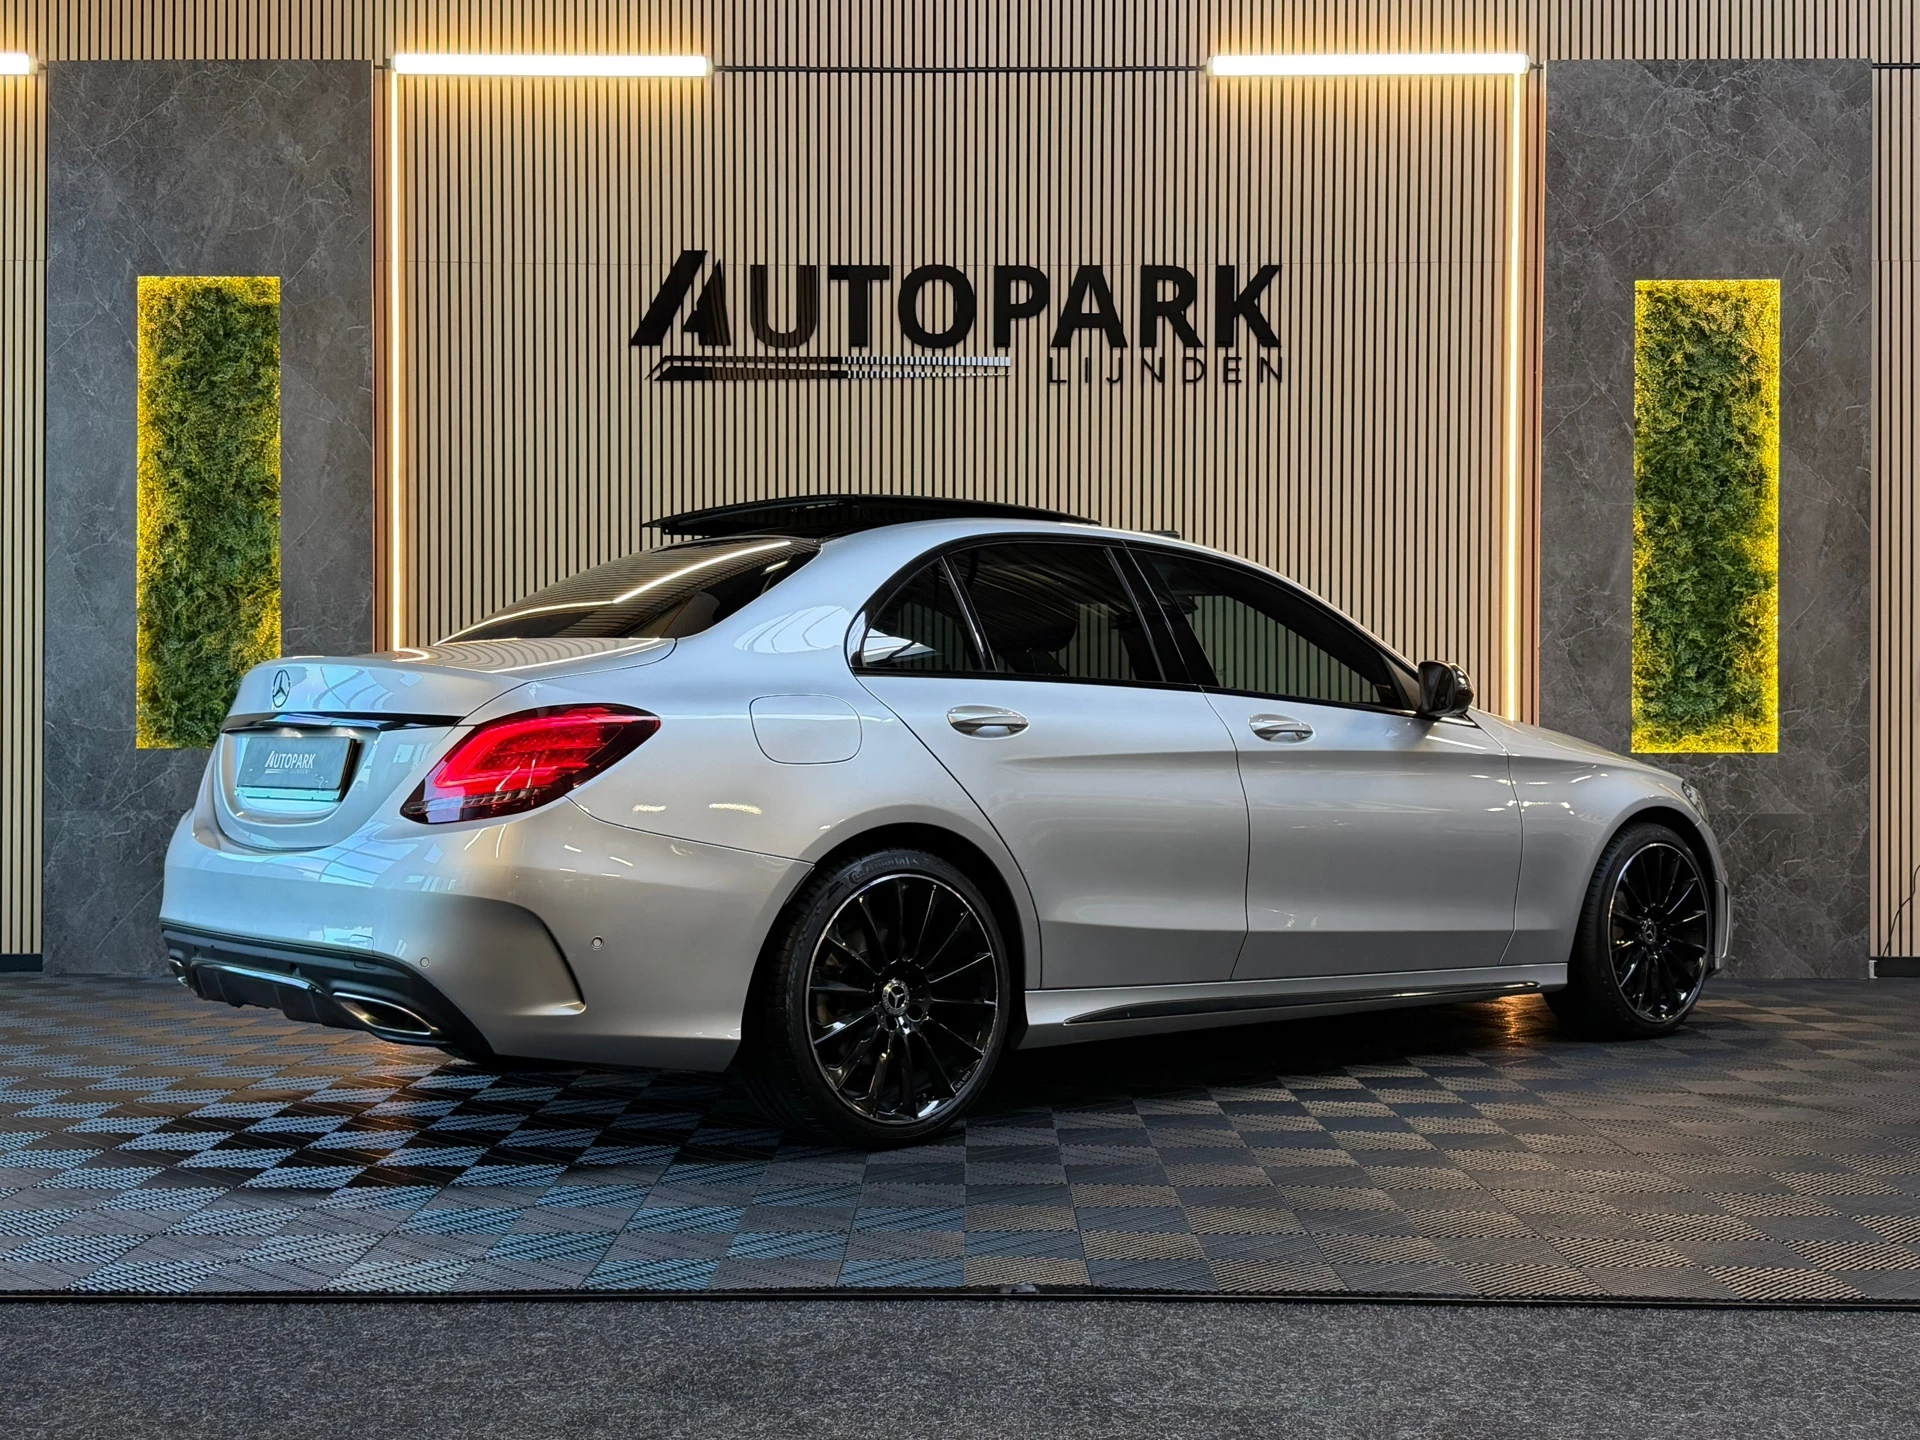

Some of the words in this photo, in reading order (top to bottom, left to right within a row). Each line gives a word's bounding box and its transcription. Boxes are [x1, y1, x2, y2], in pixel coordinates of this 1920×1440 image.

[629, 249, 1283, 348] AUTOPARK
[1048, 357, 1283, 384] LIJNDEN
[265, 751, 316, 769] AUTOPARK
